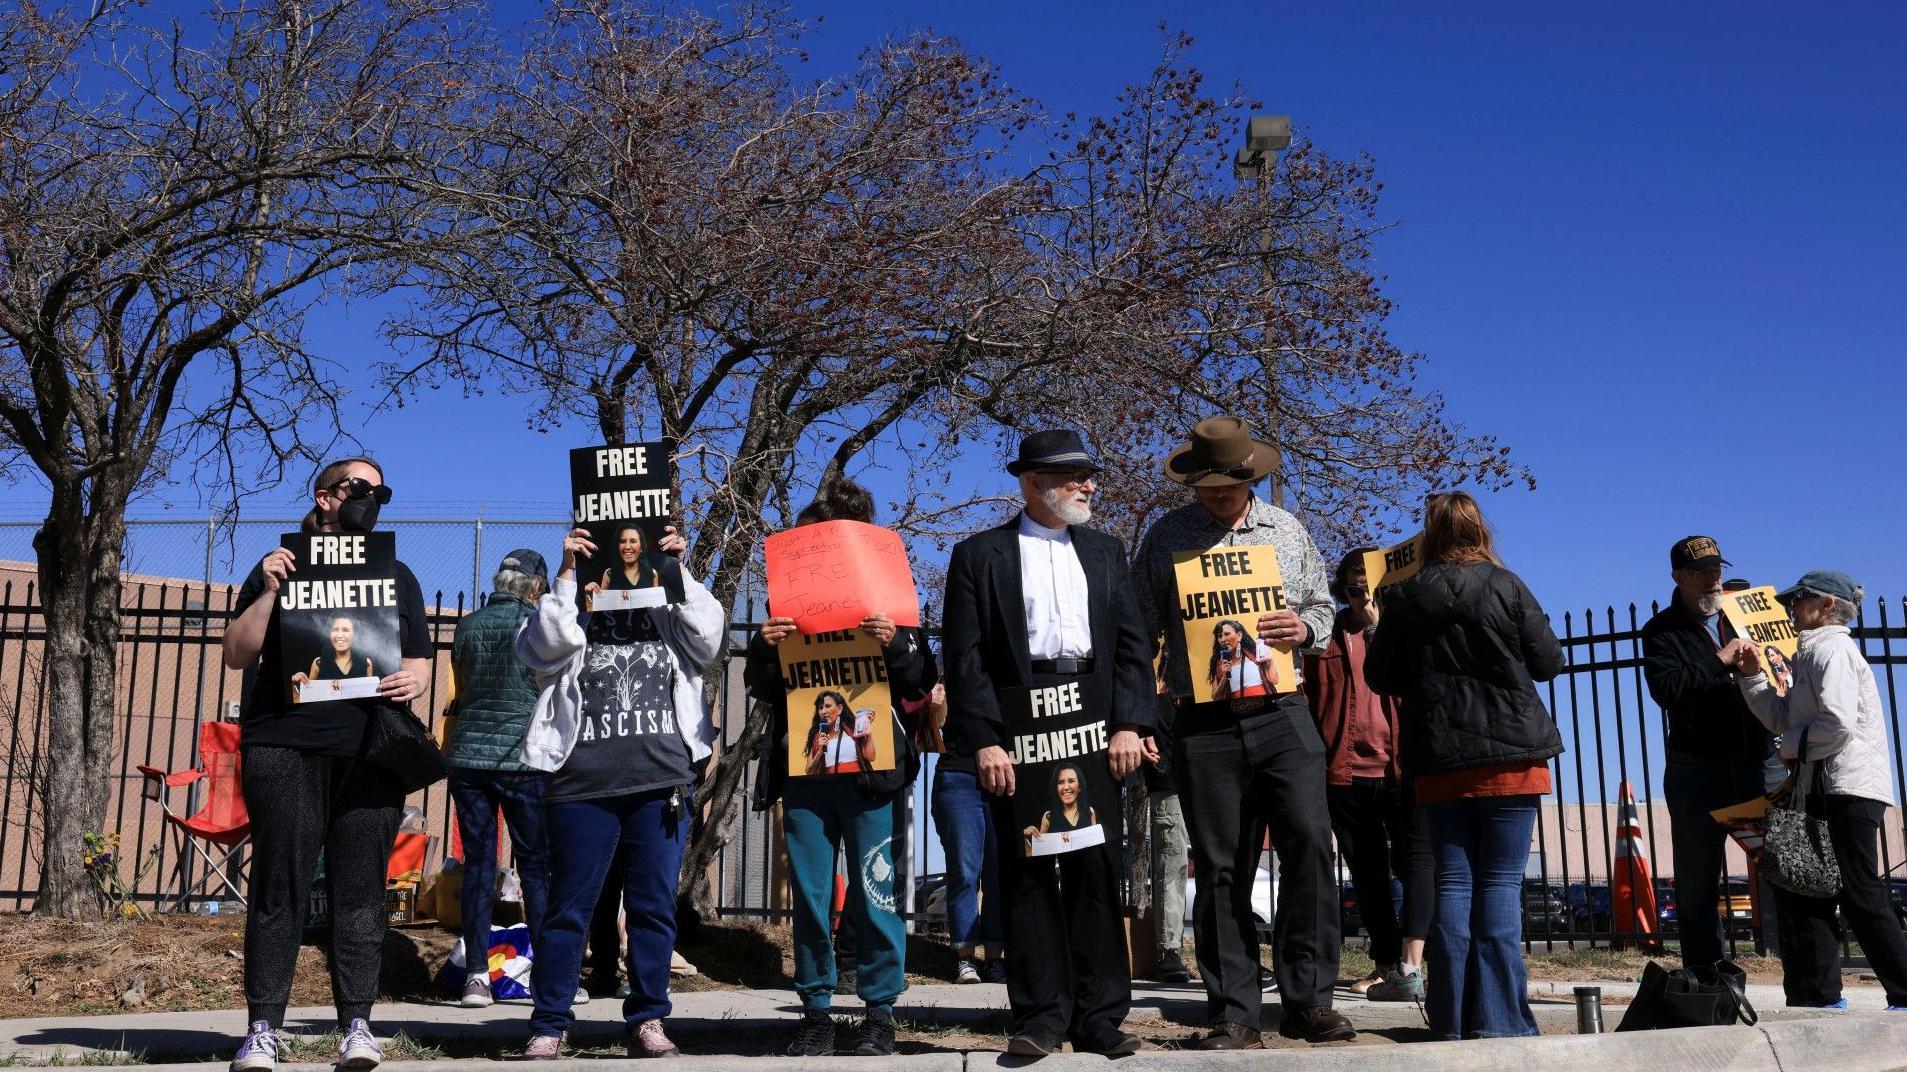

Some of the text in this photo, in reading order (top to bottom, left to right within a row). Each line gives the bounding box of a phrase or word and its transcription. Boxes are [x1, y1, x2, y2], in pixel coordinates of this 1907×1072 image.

[596, 446, 648, 478] FREE
[574, 488, 670, 523] JEANETTE
[310, 535, 366, 565] FREE
[1200, 551, 1253, 578] FREE
[1384, 542, 1416, 574] FREE
[280, 578, 397, 610] JEANETTE
[1180, 585, 1287, 622] JEANETTE
[1734, 591, 1772, 615] FREE
[1744, 619, 1799, 643] EANETTE
[783, 655, 888, 690] JEANETTE
[1029, 681, 1083, 719] FREE
[582, 709, 675, 741] ASCISM
[1007, 719, 1109, 765] JEANETTE
